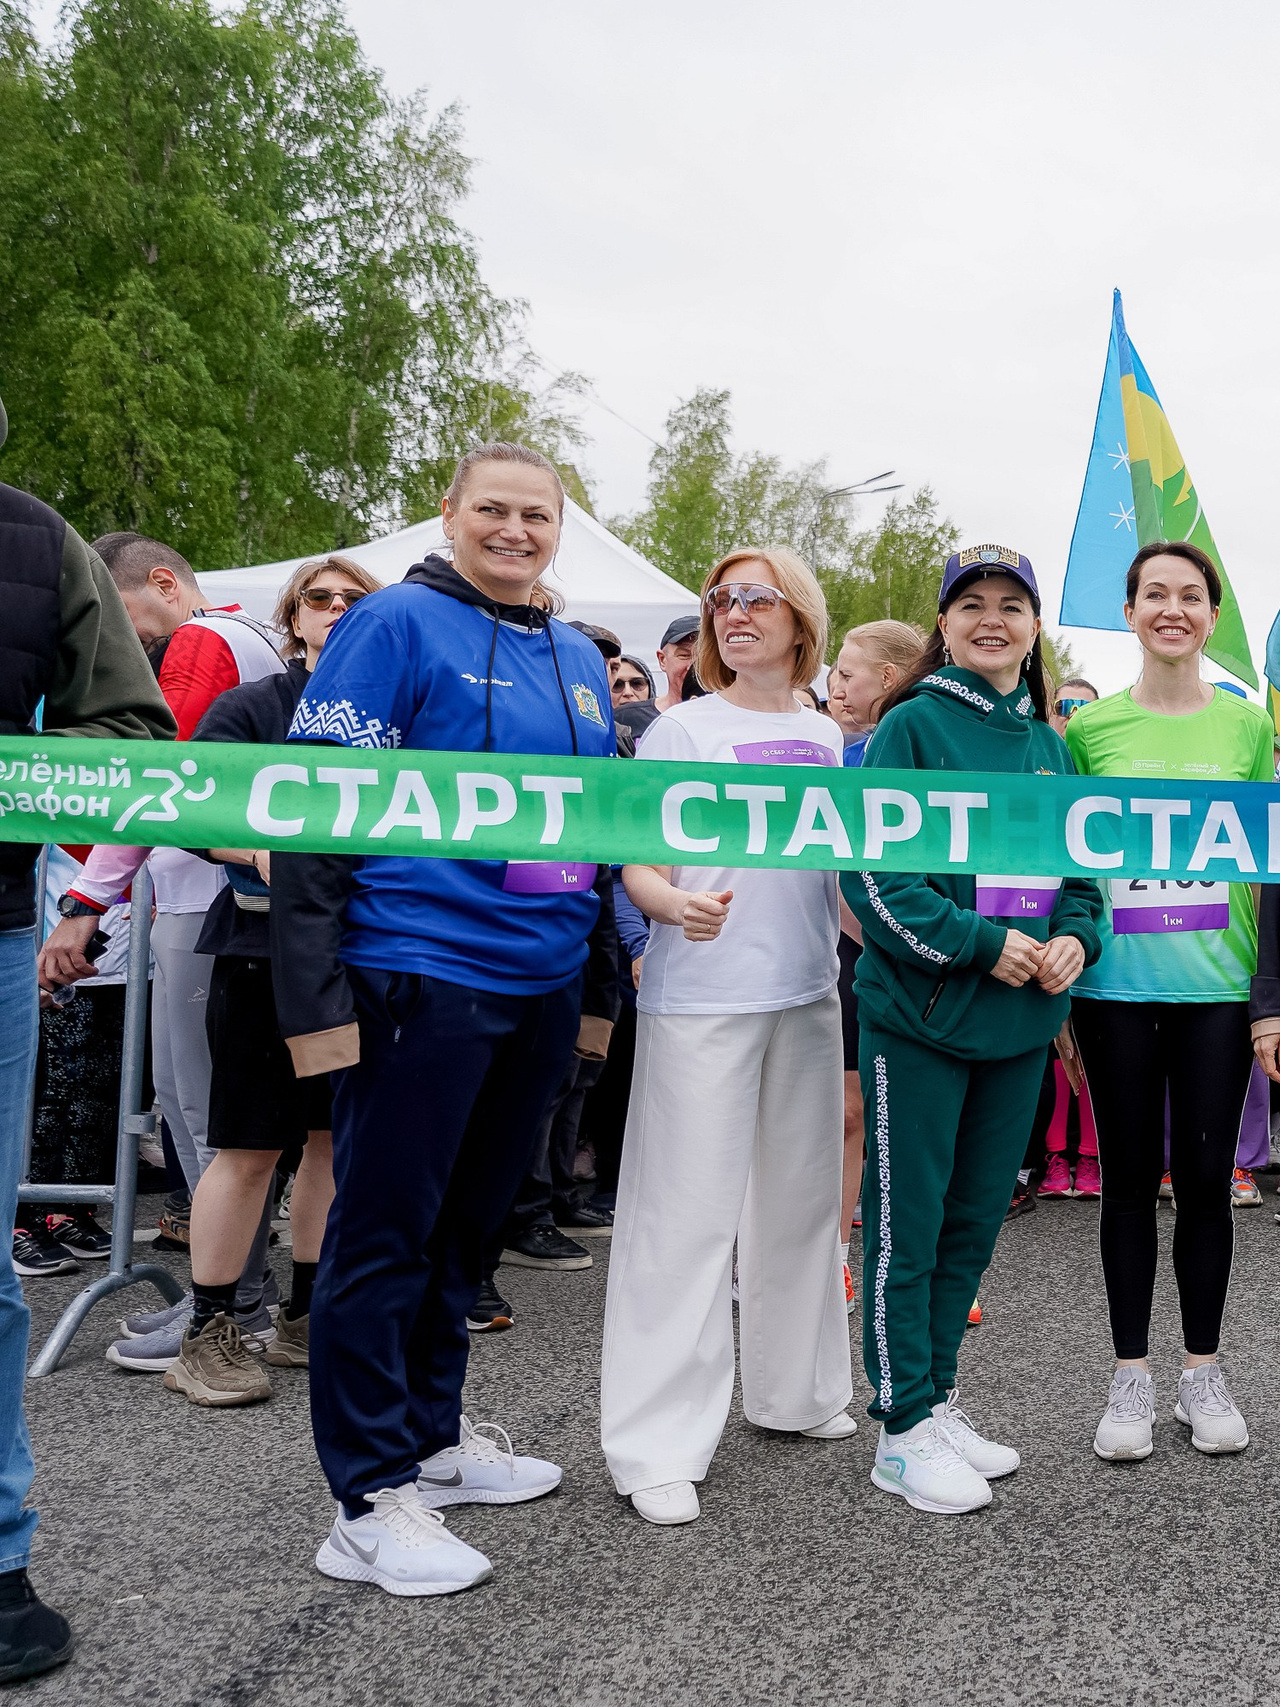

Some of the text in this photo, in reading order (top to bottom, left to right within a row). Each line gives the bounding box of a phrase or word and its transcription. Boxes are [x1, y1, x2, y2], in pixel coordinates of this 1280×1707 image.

[0, 753, 131, 788] лёный
[246, 764, 583, 844] СТАРТ
[662, 781, 989, 863] СТАРТ
